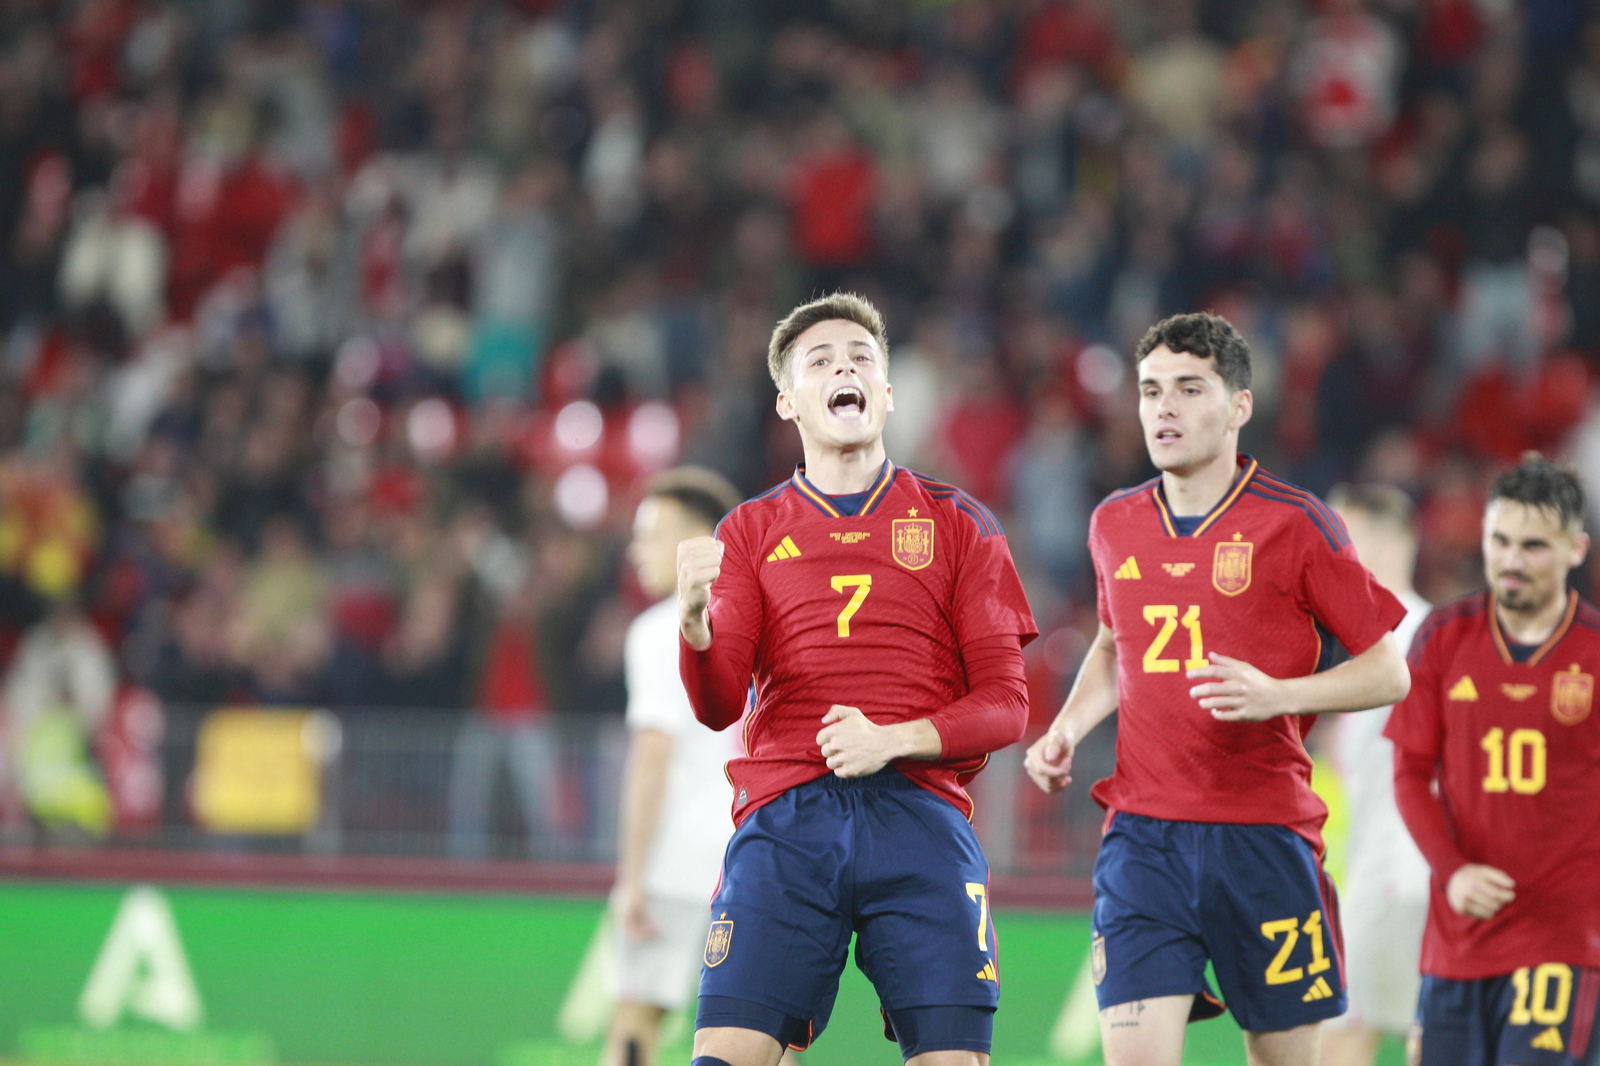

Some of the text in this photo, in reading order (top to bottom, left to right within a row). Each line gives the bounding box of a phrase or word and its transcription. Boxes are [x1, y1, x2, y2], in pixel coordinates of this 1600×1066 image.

[830, 574, 872, 638] 7
[1142, 605, 1209, 674] 21
[1482, 728, 1547, 794] 10
[965, 882, 988, 952] 7
[1260, 910, 1331, 985] 21
[80, 887, 204, 1030] A
[1510, 963, 1573, 1026] 10
